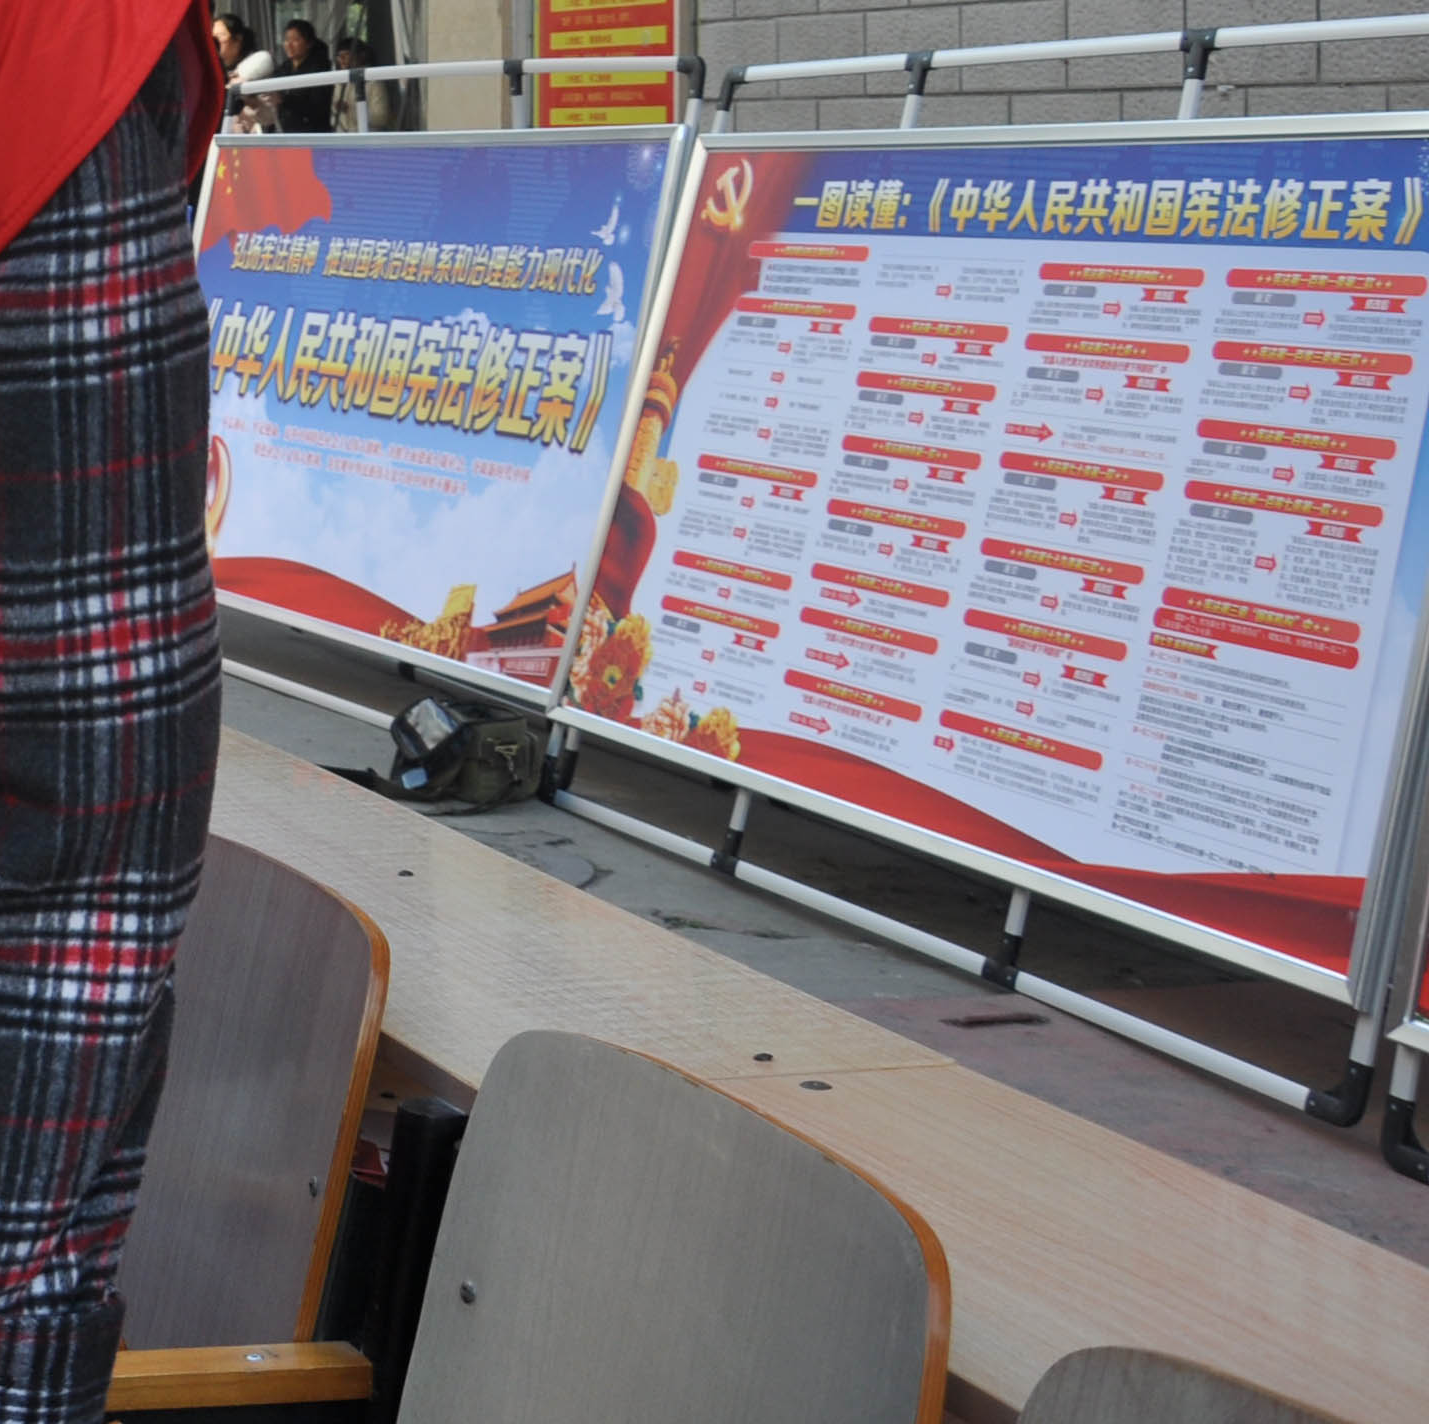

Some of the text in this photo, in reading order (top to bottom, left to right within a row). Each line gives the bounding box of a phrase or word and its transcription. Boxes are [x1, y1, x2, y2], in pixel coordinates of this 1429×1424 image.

[230, 231, 605, 296] 弘扬宪法精神 推进国家治理体系和治理能力现代化
